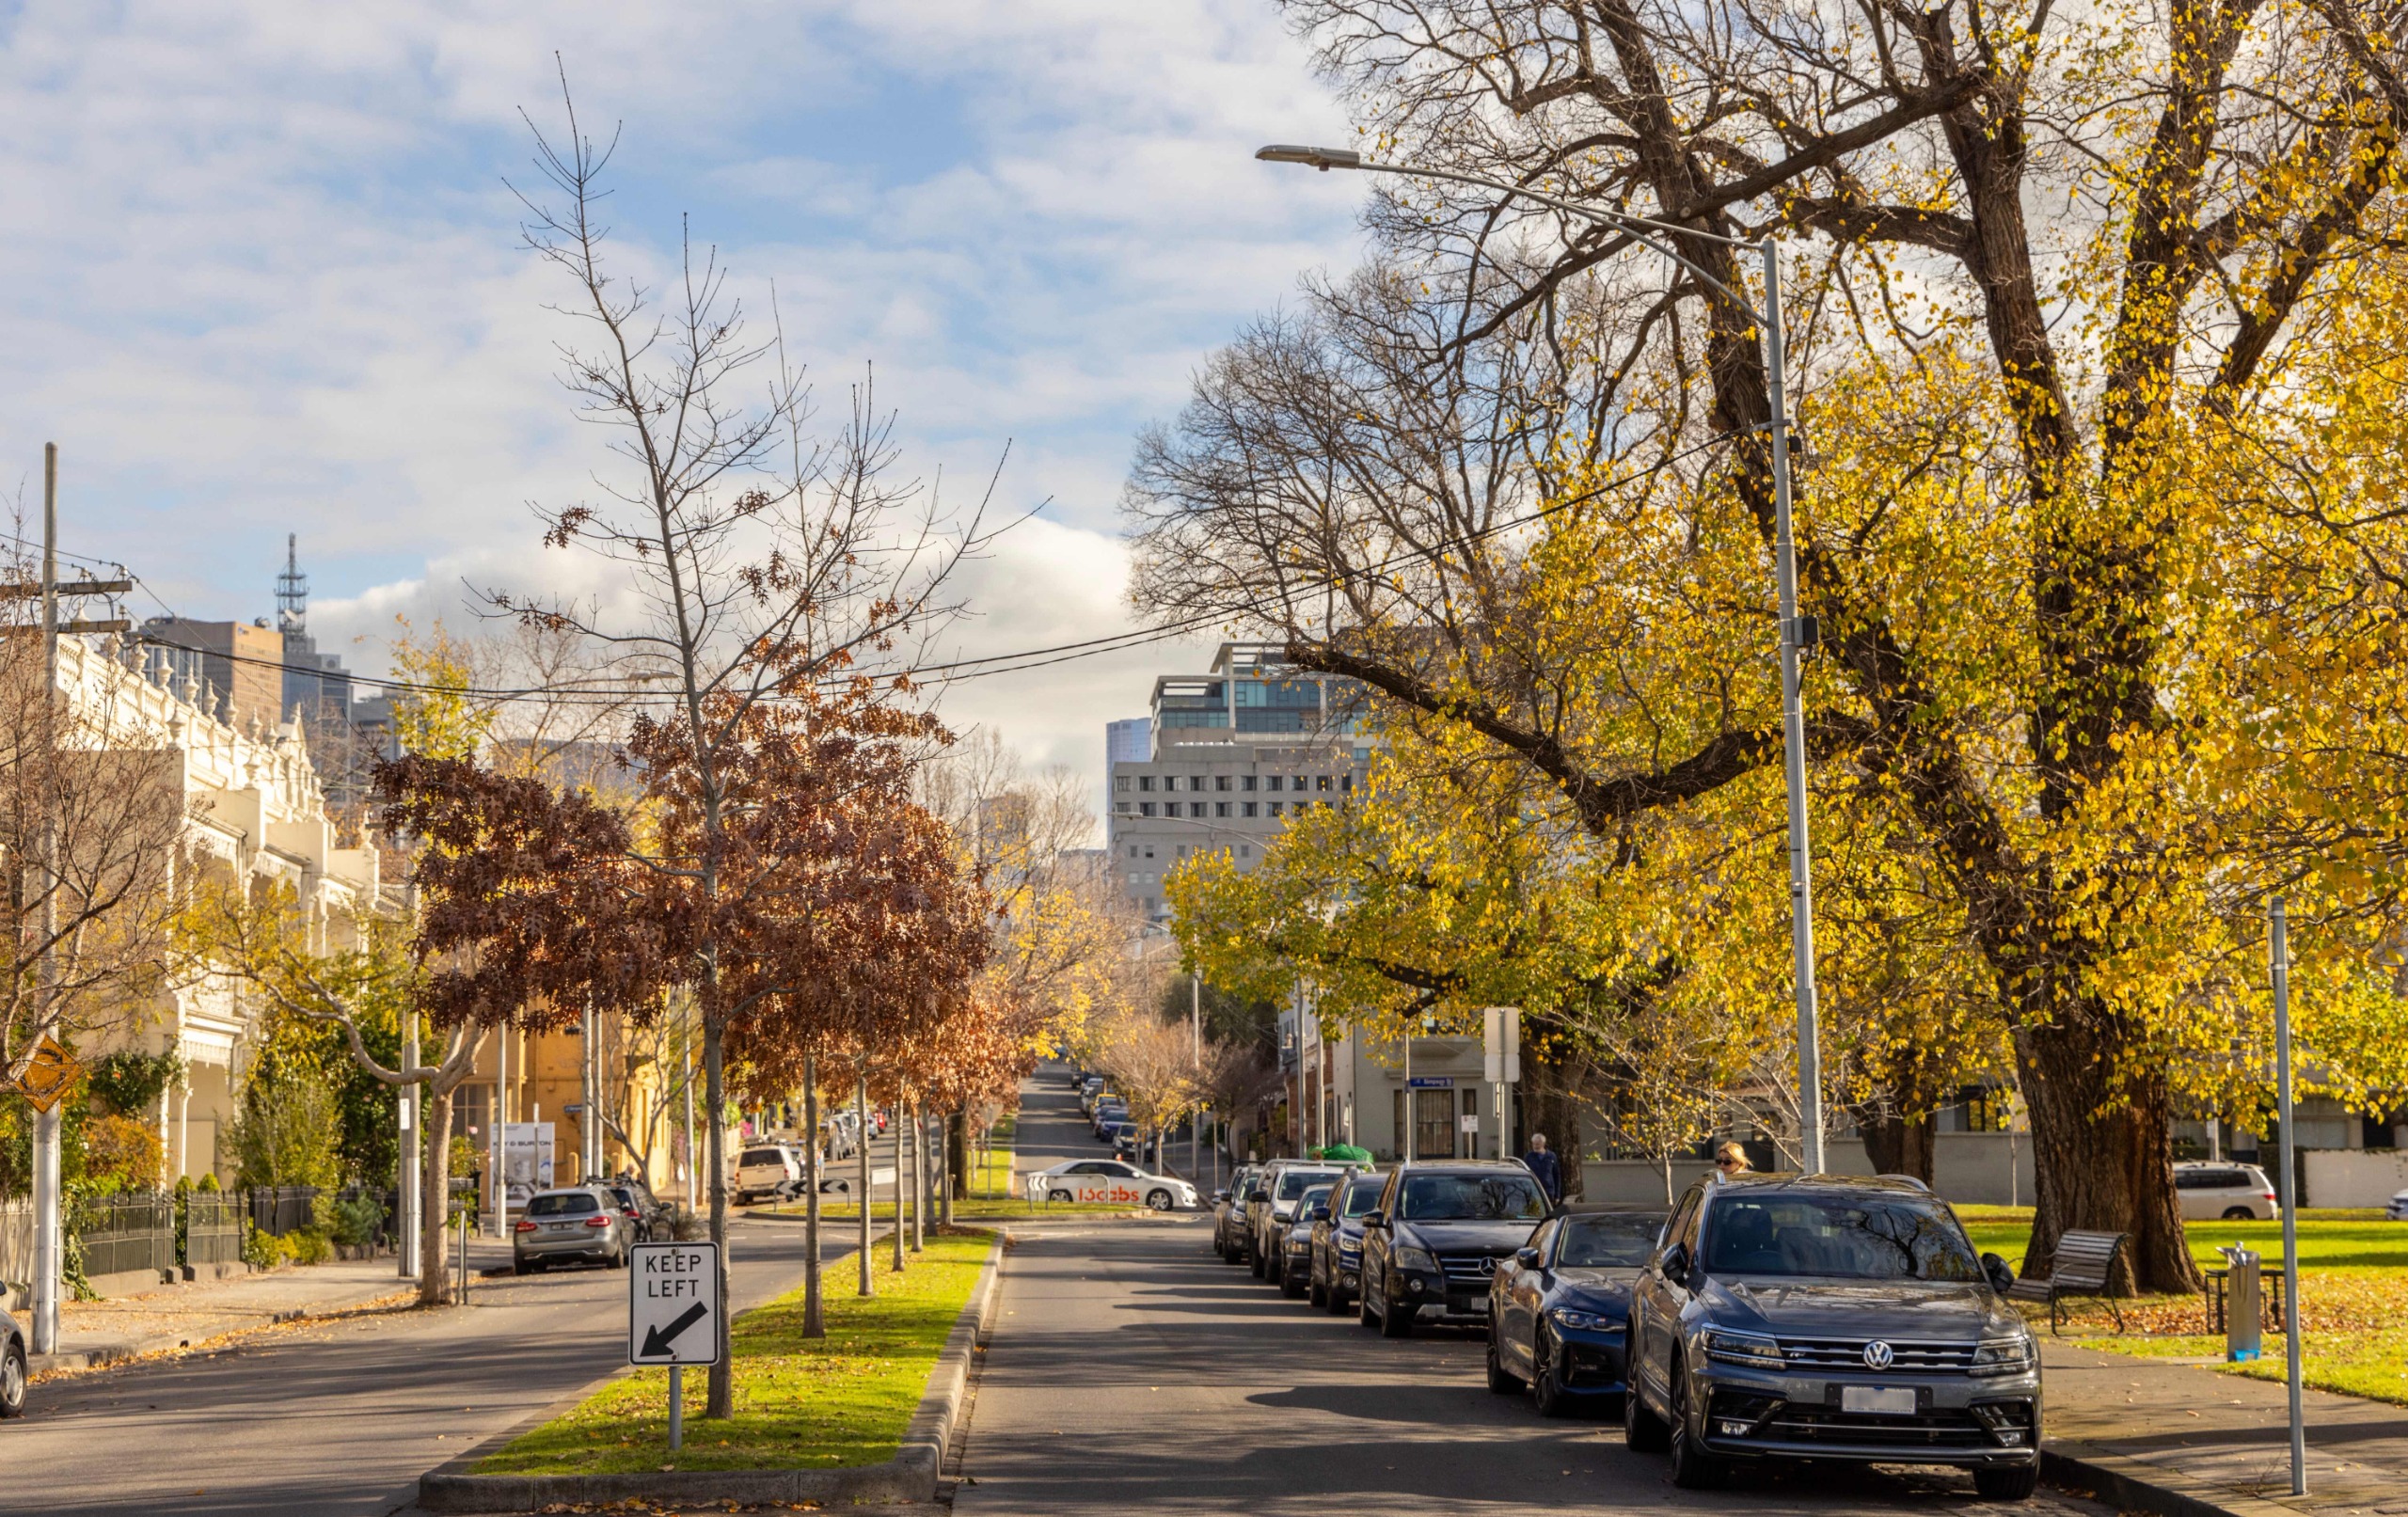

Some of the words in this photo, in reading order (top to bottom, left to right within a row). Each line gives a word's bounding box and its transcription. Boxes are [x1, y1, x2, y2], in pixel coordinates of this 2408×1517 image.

[1079, 1185, 1139, 1202] 13cabs
[646, 1255, 701, 1272] KEEP
[648, 1279, 699, 1298] LEFT
